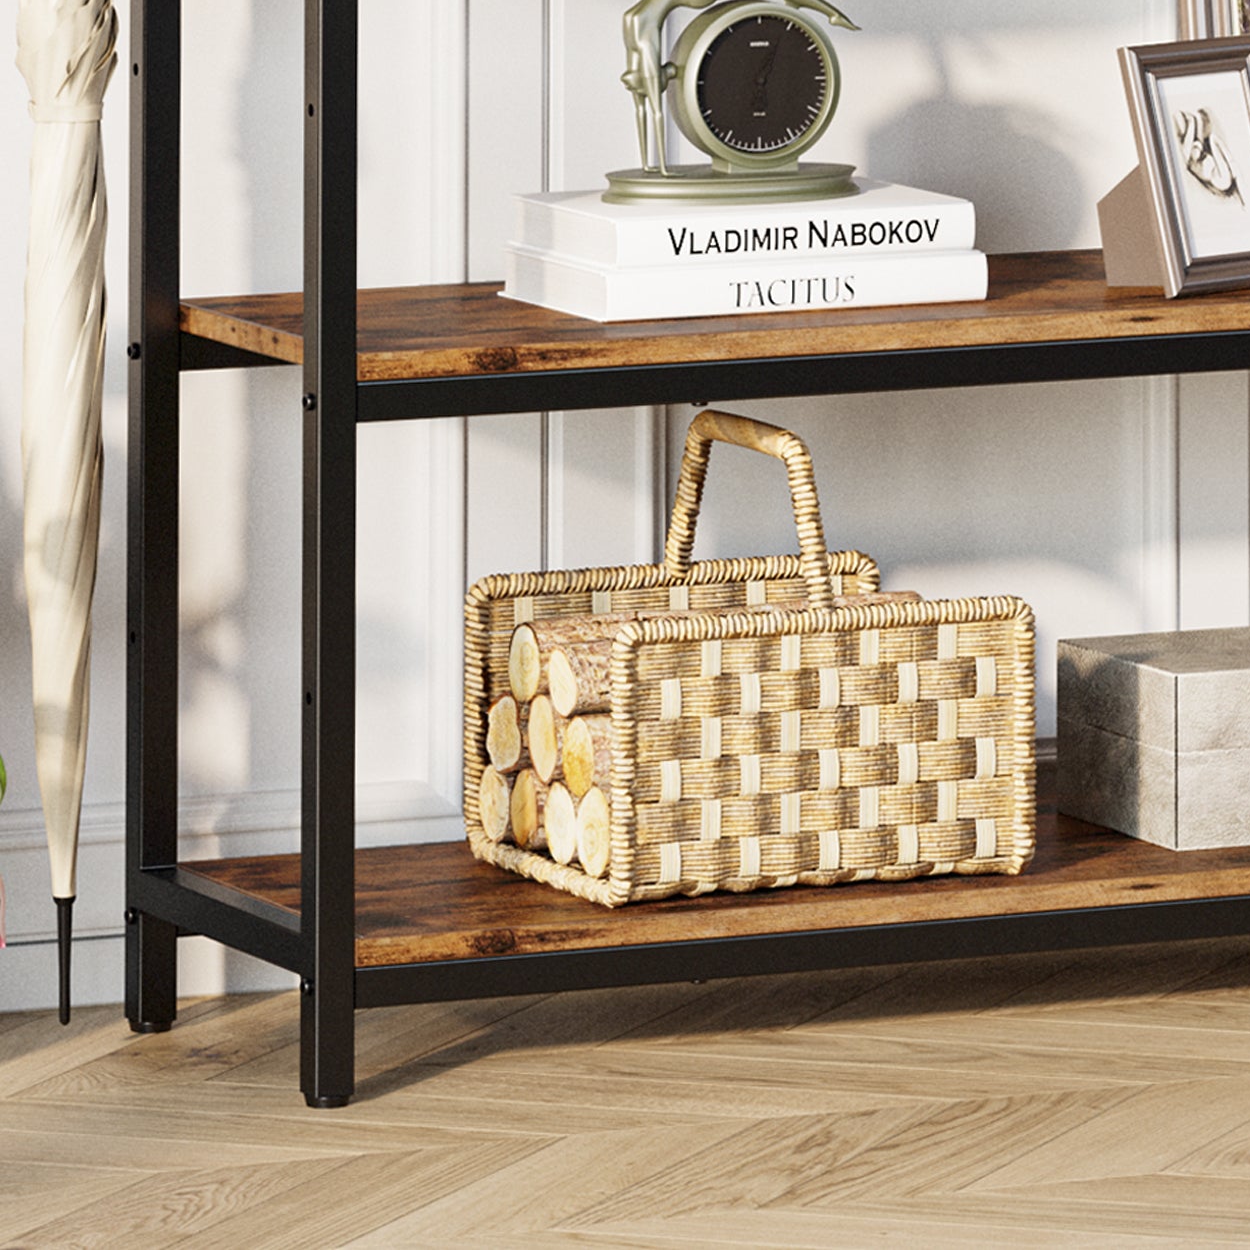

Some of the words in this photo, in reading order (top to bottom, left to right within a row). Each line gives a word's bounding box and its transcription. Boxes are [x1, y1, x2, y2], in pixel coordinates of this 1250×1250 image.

[668, 226, 798, 256] VLADIMIR
[807, 218, 940, 249] NABOKOV
[729, 275, 856, 308] TACITUS
